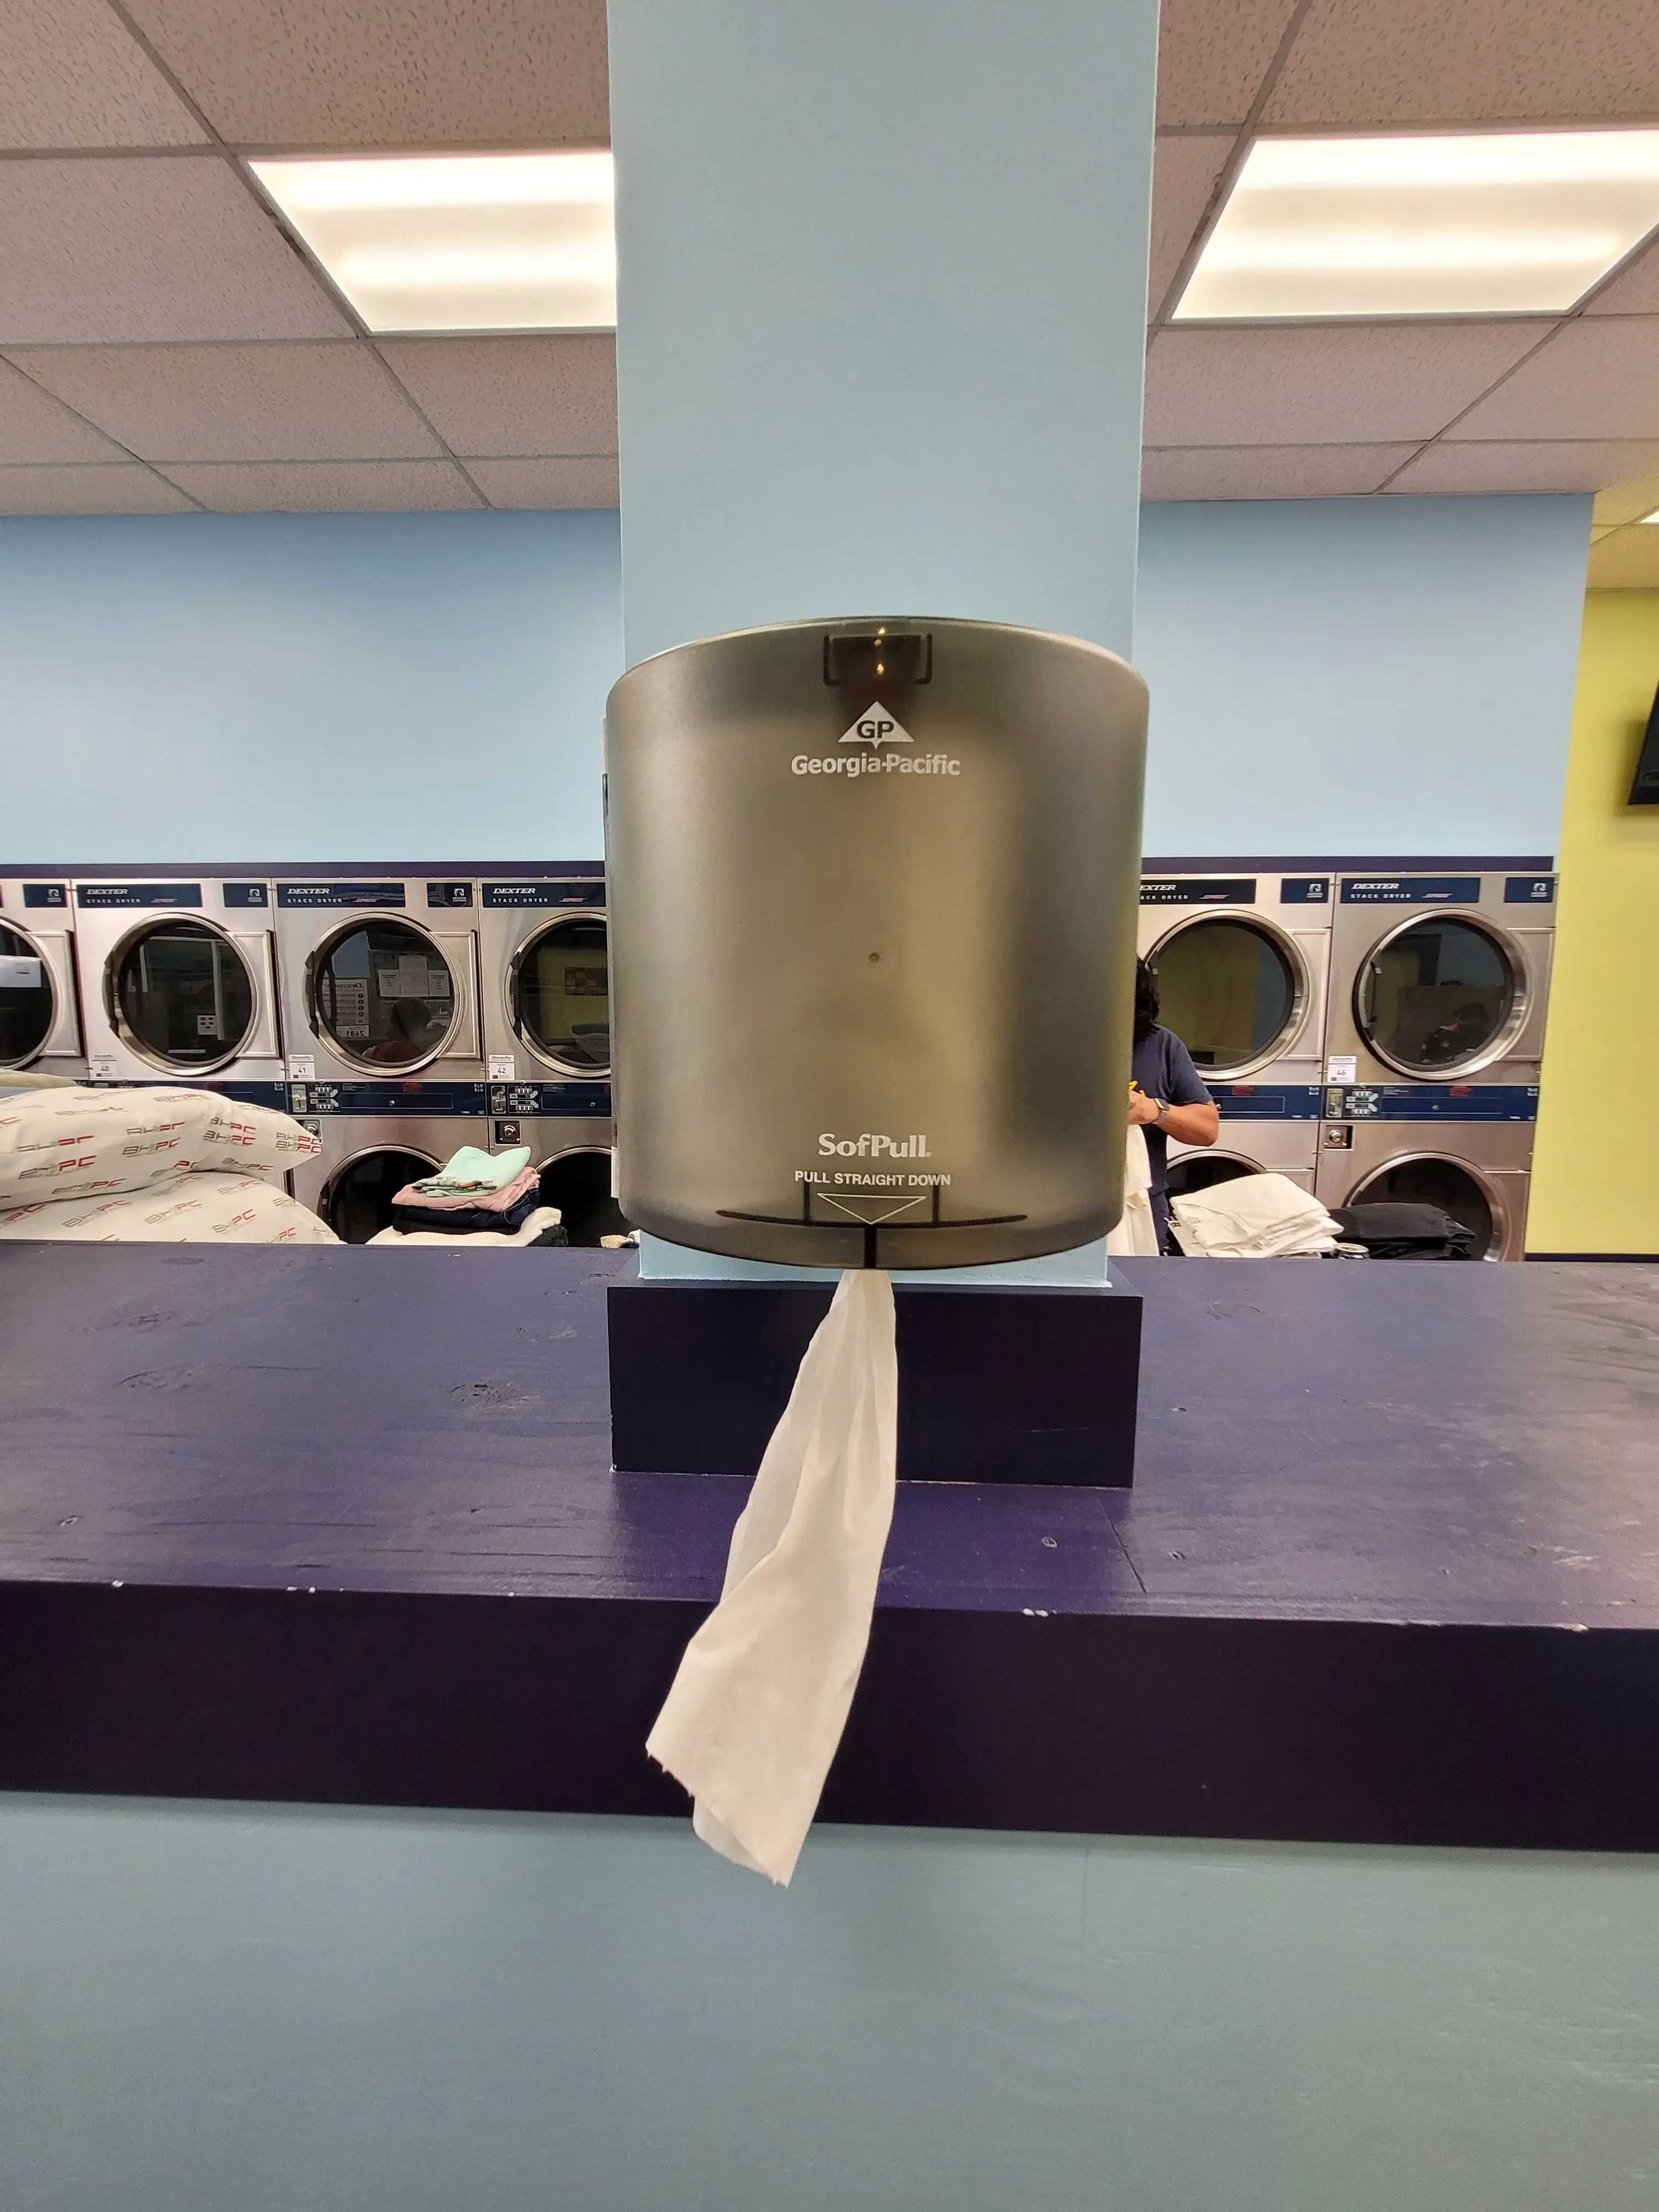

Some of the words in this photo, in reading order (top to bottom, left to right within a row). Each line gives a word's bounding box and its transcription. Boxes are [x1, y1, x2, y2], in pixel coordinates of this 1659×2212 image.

[857, 721, 895, 739] GP
[122, 1137, 181, 1155] BHPC
[203, 1130, 256, 1145] BHPC
[795, 1171, 831, 1183] PULL
[834, 1173, 904, 1186] STRAIGHT
[909, 1174, 951, 1186] DOWN
[144, 1200, 202, 1224] BHPC
